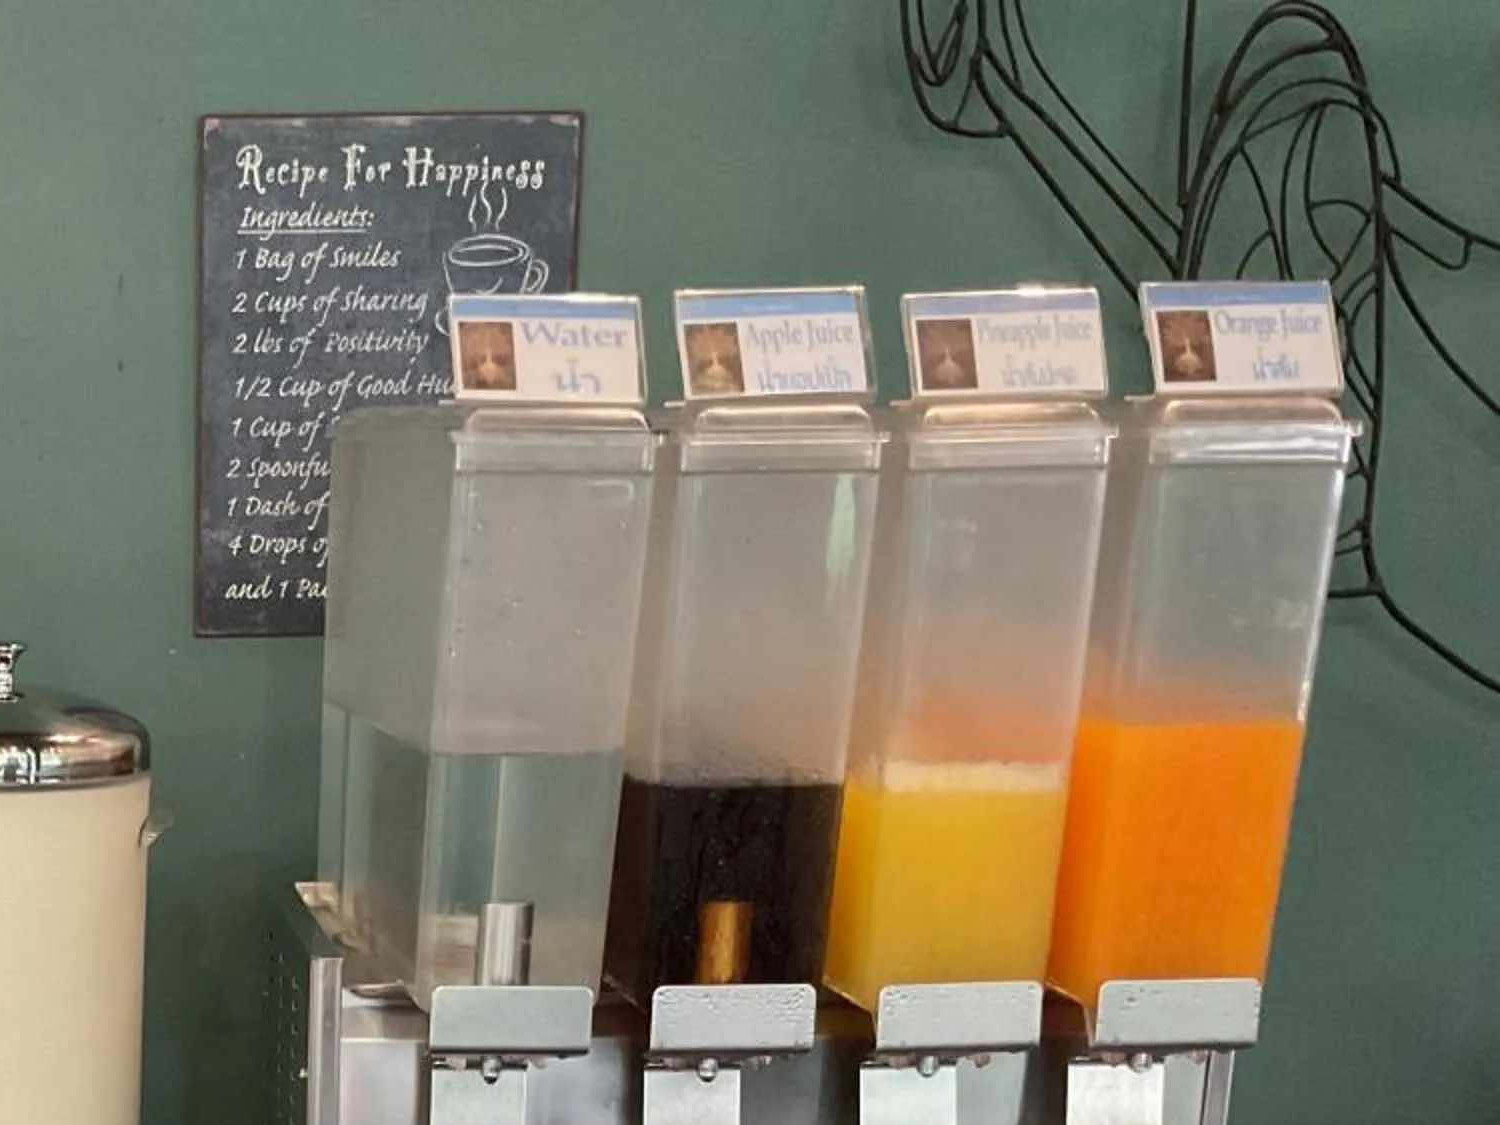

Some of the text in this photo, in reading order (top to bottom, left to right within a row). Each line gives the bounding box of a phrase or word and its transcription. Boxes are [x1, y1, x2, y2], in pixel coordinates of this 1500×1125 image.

[235, 142, 546, 199] Recipe For Happiness
[238, 201, 376, 241] Ingredients:
[236, 240, 403, 285] 1 Bag of Smiles
[232, 291, 249, 314] 2
[254, 291, 309, 326] Cups
[312, 285, 341, 328] of
[1215, 307, 1325, 342] Orange Juice
[232, 332, 249, 354] 2
[253, 327, 284, 354] lbs
[289, 328, 318, 370] of
[521, 321, 628, 347] Water
[749, 317, 854, 357] Apple Juice
[1053, 312, 1094, 350] Juice
[234, 369, 457, 413] 1/2 Cup of Good Hu
[552, 357, 601, 394] น้ำ
[232, 411, 326, 452] 1 Cup of
[226, 451, 332, 490] 2 Spoonfu
[227, 490, 331, 531] 1 Dash of
[228, 535, 242, 556] 4
[249, 534, 307, 565] Drops
[225, 573, 273, 600] and
[279, 579, 289, 599] 1
